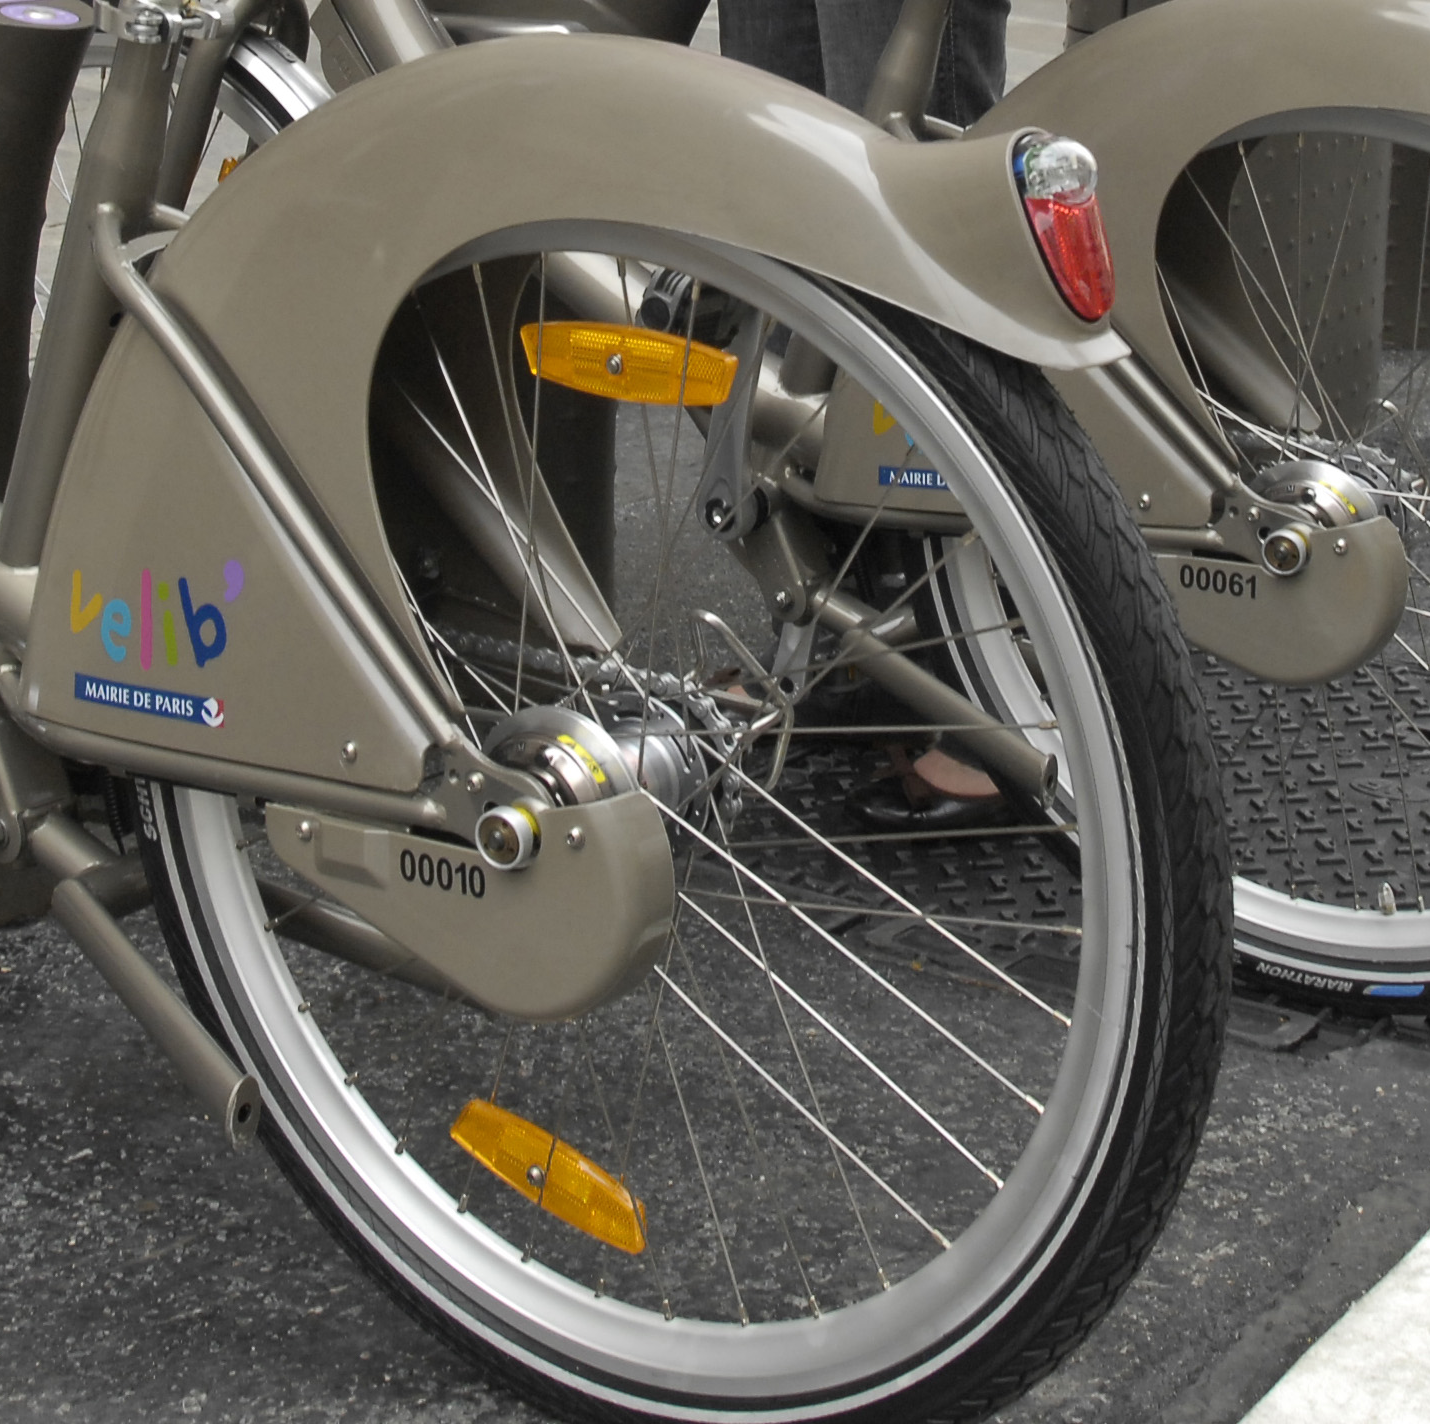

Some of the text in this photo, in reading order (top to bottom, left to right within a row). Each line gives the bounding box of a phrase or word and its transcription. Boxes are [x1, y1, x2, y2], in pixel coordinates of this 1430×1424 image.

[889, 470, 932, 486] MAIRIE
[1179, 564, 1256, 599] 00061
[71, 558, 245, 671] velib'
[85, 681, 194, 717] MAIRIE DE PARIS
[400, 849, 486, 898] 00010
[1256, 962, 1354, 993] MARATHON
